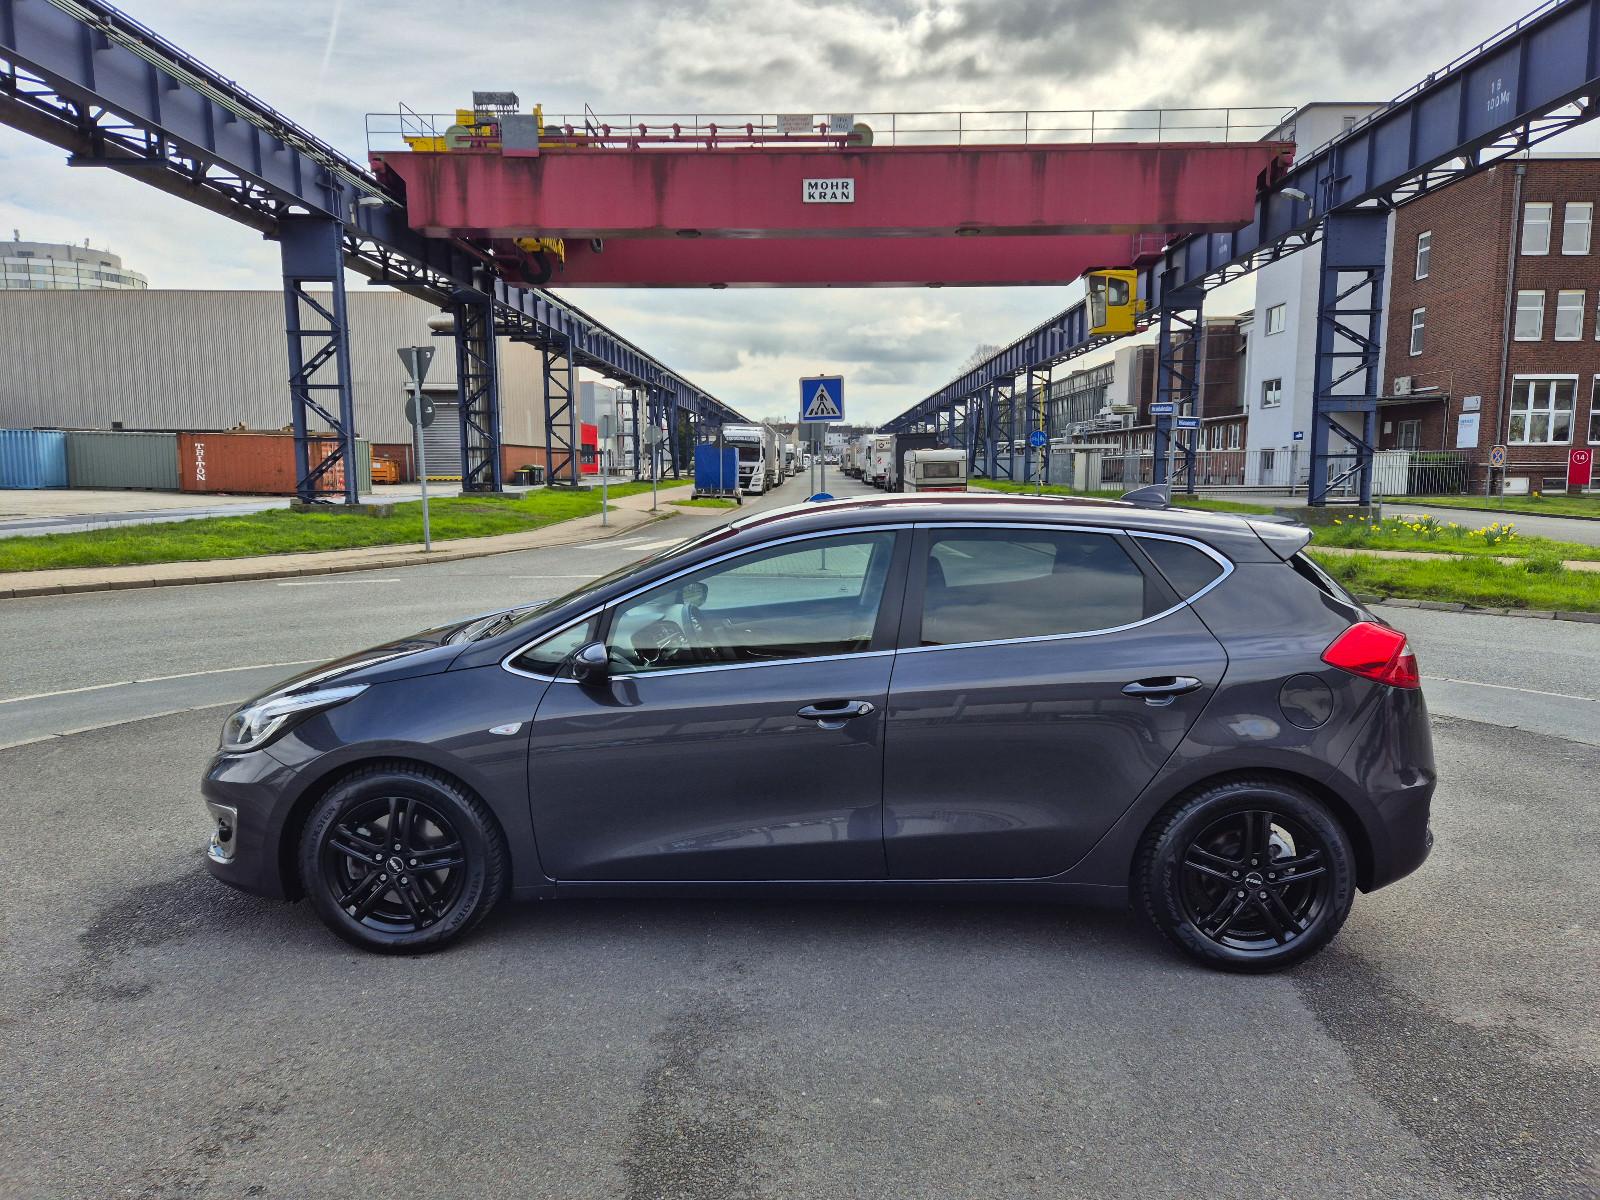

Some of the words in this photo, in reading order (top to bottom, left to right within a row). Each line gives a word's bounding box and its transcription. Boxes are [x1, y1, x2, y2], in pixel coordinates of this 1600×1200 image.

[808, 181, 850, 190] MOHR
[808, 191, 850, 200] KRAN
[195, 442, 206, 481] TRITON
